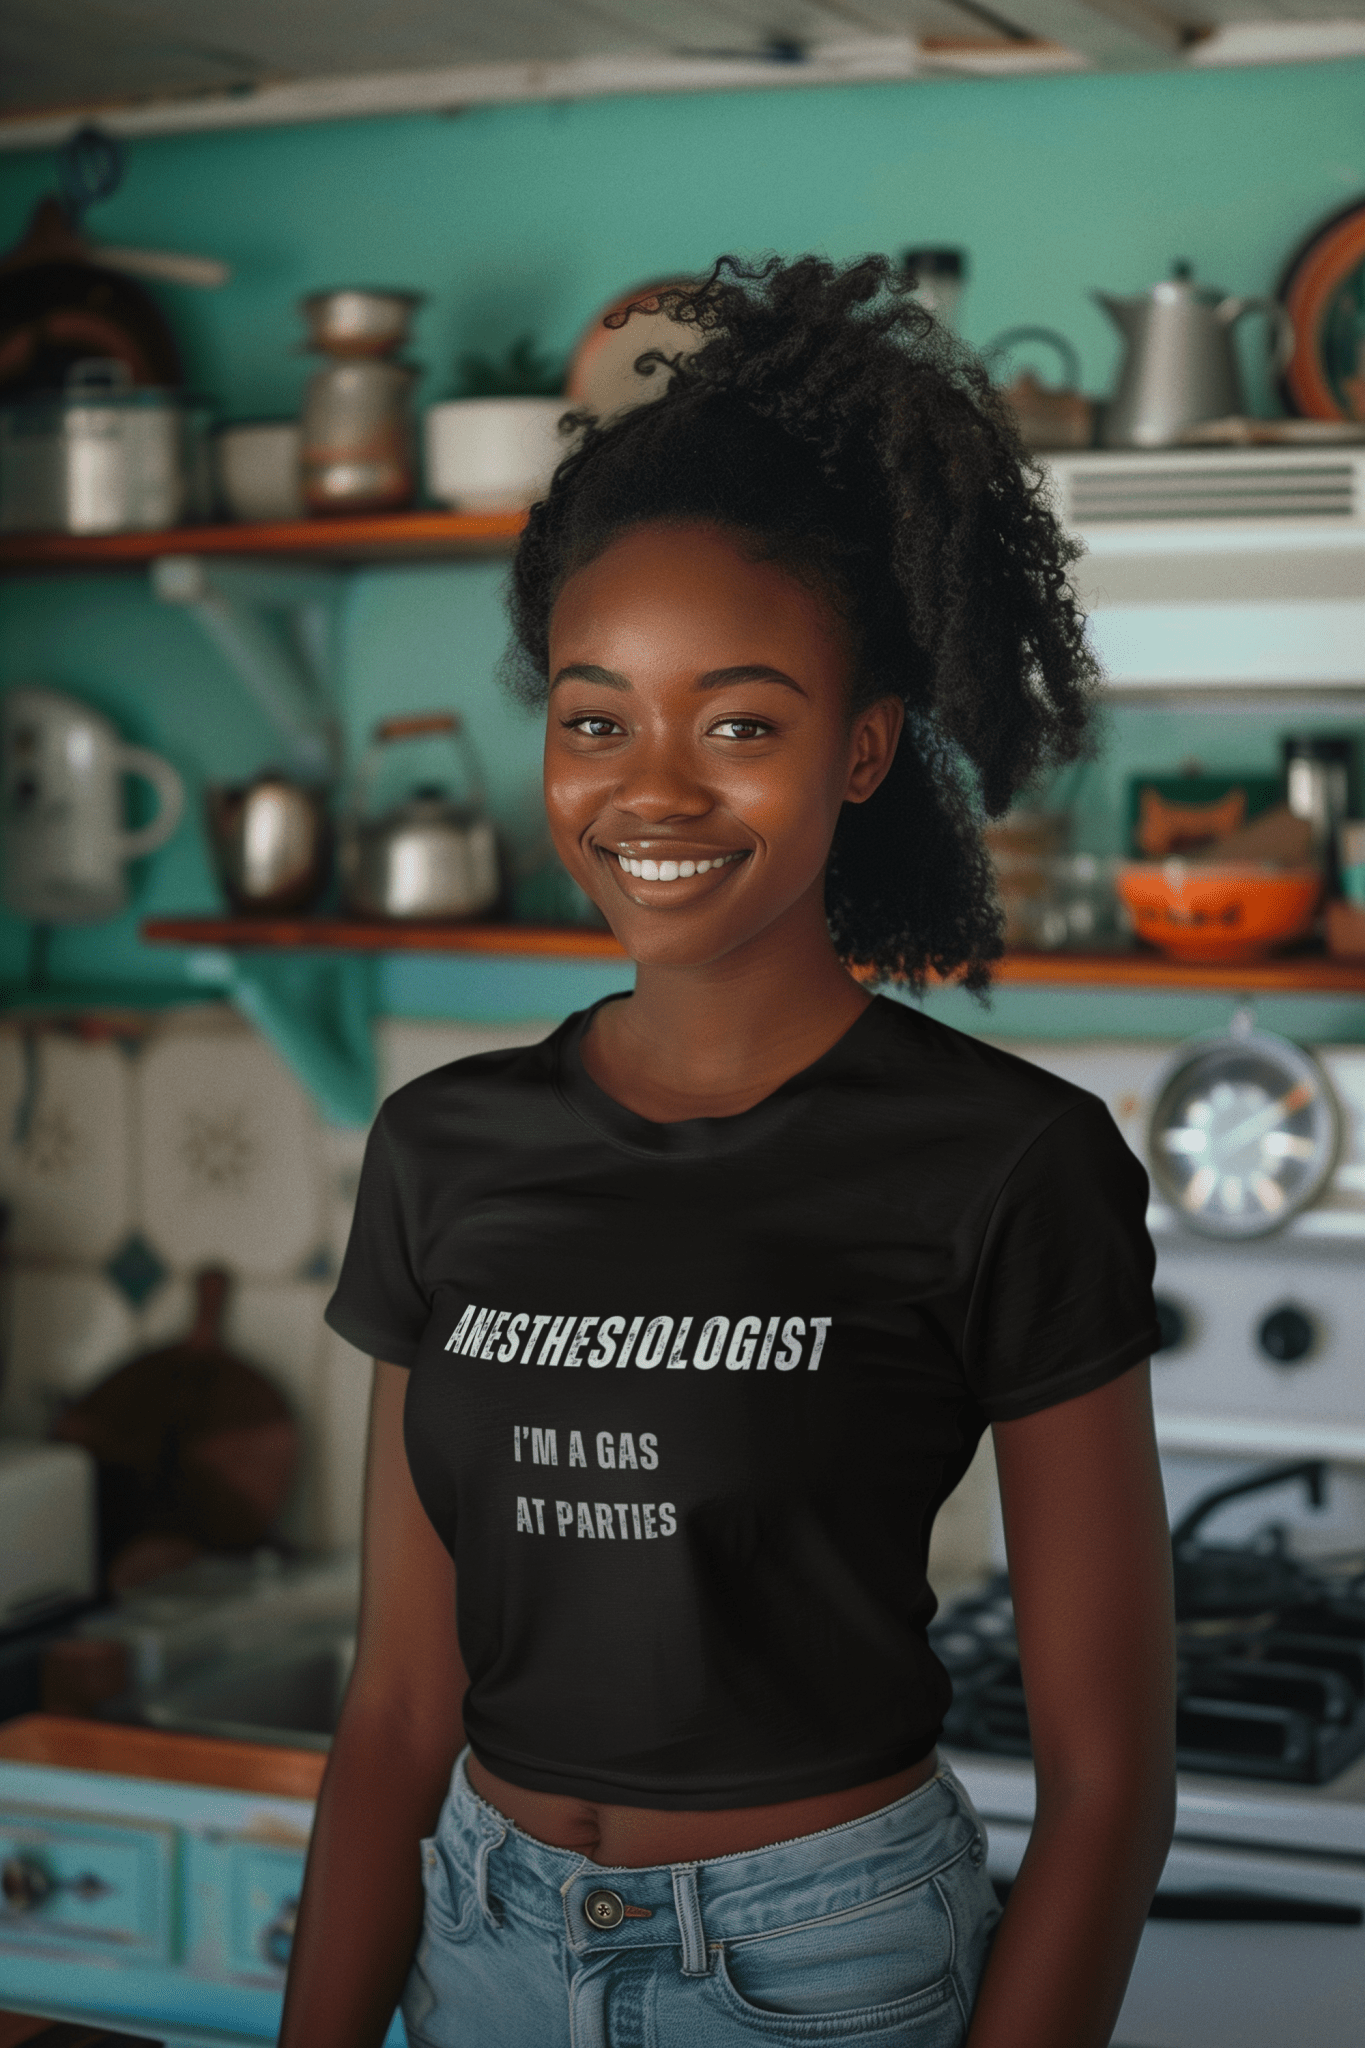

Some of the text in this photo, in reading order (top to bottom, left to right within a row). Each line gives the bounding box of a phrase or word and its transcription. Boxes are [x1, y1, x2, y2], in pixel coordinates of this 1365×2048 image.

[444, 1304, 832, 1371] ANESTHESIOLOGIST
[514, 1425, 659, 1470] I'M A GAS
[517, 1496, 677, 1540] AT PARTIES
